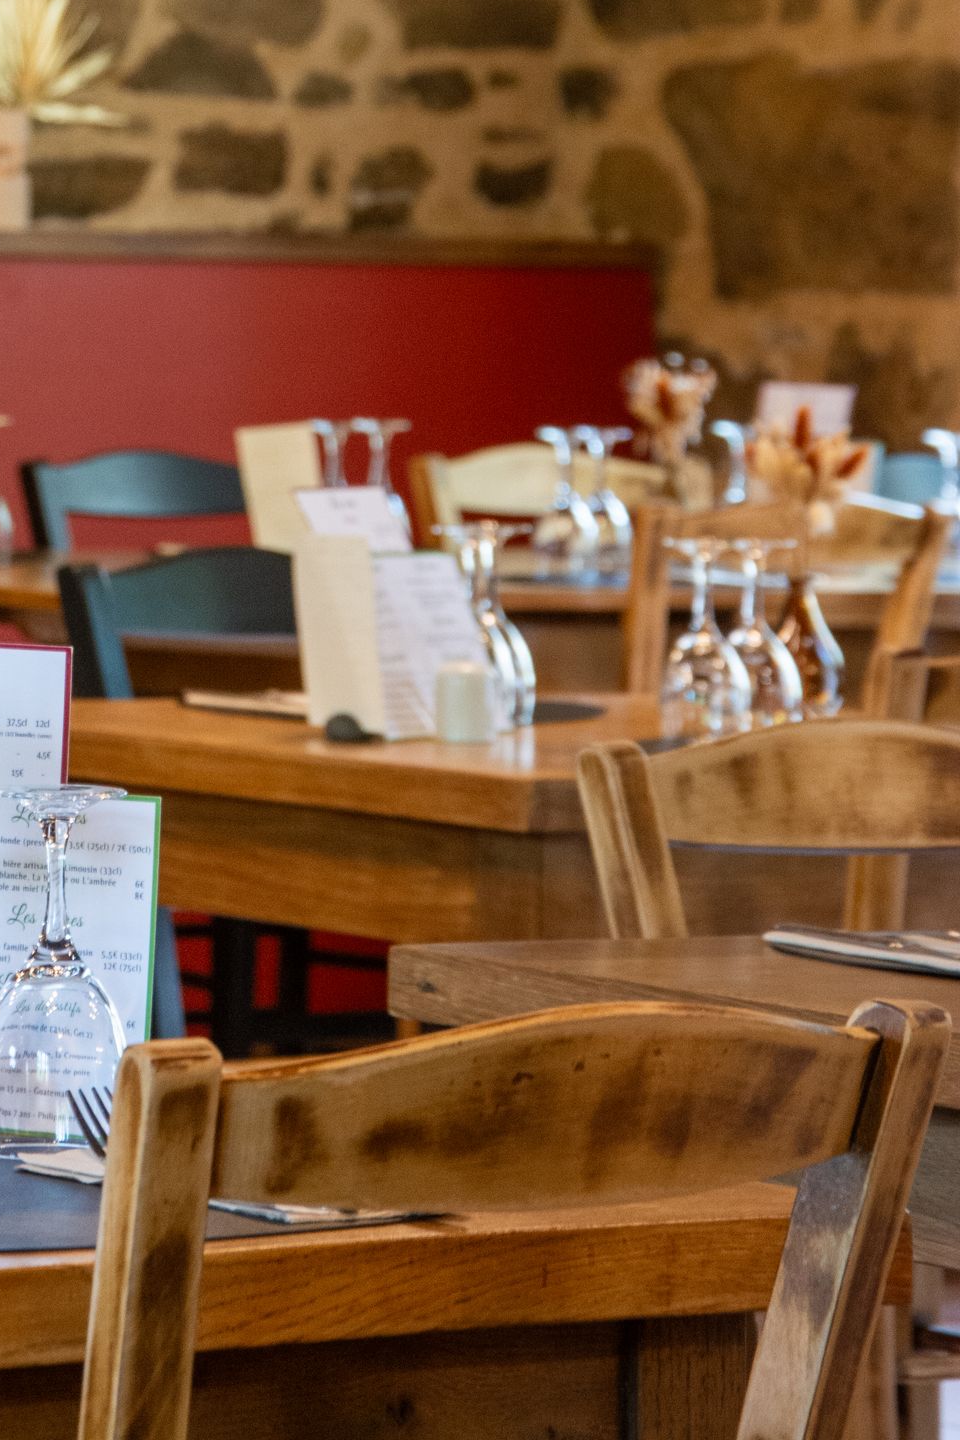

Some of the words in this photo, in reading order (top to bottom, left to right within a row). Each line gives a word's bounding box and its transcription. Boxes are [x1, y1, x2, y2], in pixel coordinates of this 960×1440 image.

[7, 718, 28, 728] 37.5cl
[35, 720, 50, 728] 12cl
[23, 837, 47, 849] (press
[3, 859, 21, 869] bière
[31, 874, 40, 883] La
[70, 877, 80, 885] ou
[12, 885, 22, 893] au
[23, 885, 40, 894] miel
[7, 903, 37, 930] Les
[3, 943, 29, 954] famille
